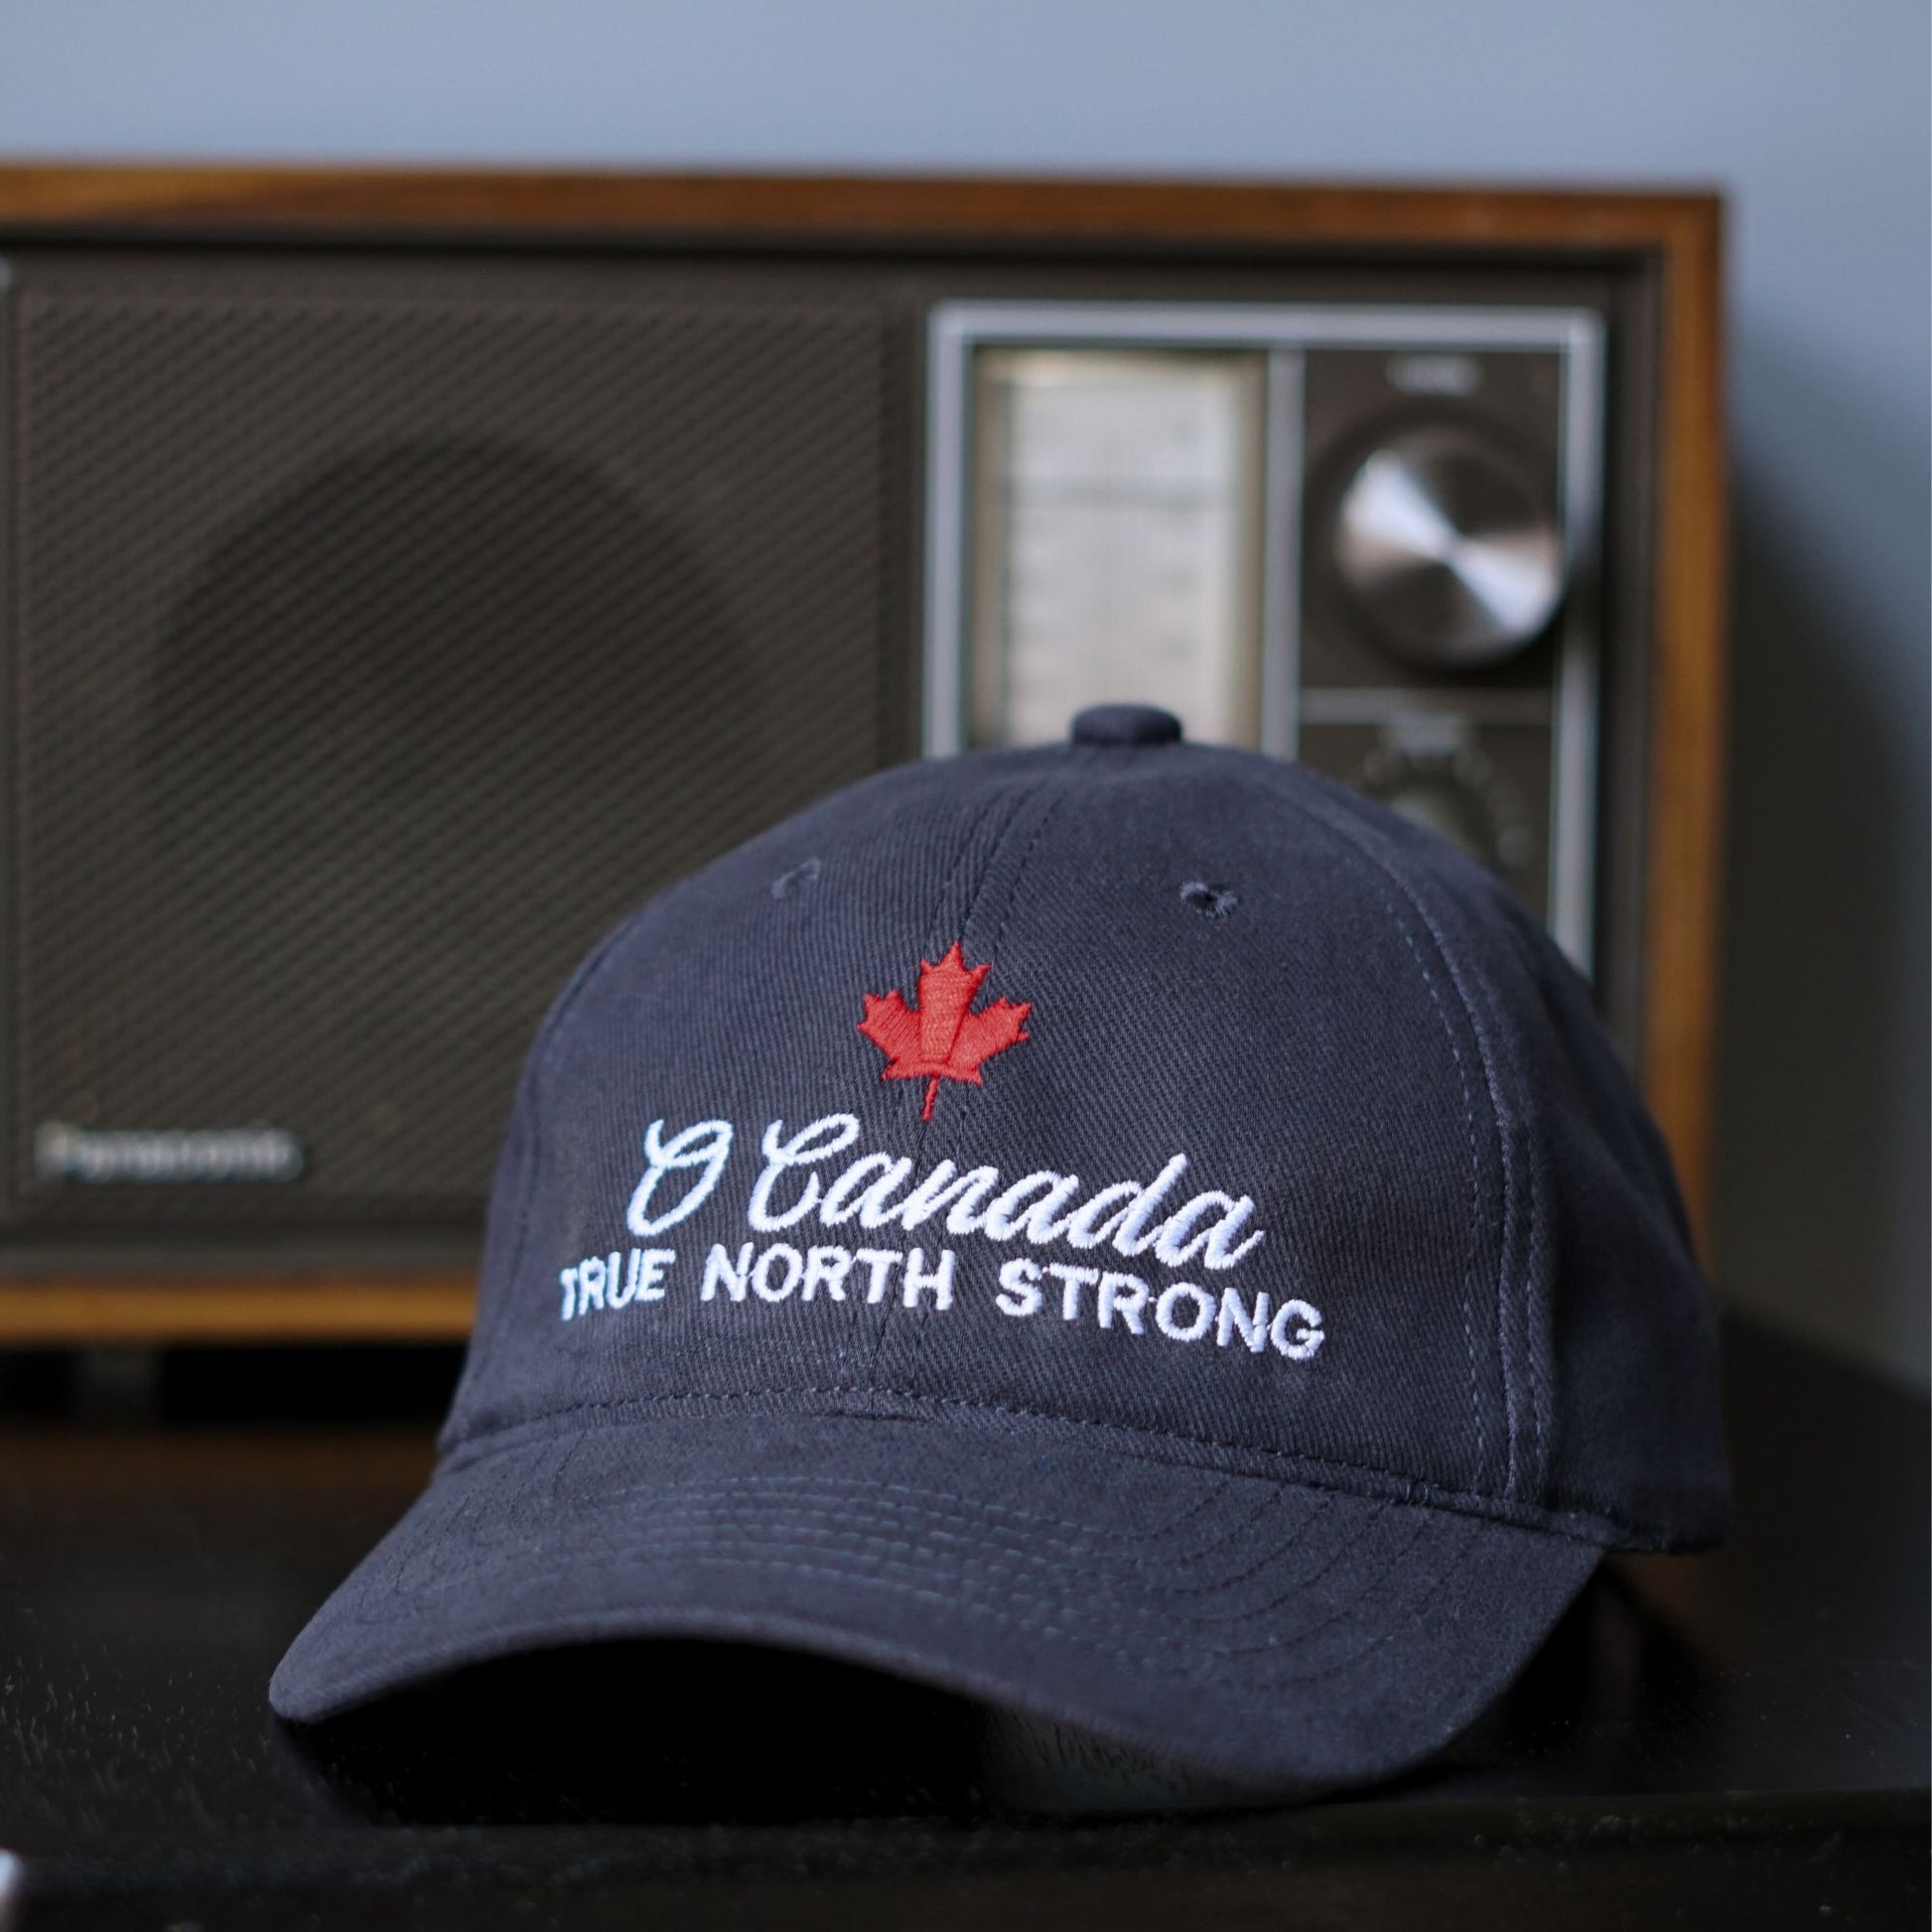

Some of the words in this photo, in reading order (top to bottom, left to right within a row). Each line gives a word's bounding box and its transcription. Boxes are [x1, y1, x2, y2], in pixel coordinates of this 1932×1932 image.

[626, 1118, 735, 1238] O
[747, 1112, 1265, 1272] Canada
[560, 1247, 677, 1321] TRUE
[699, 1241, 957, 1311] NORTH
[994, 1257, 1326, 1361] STRONG
